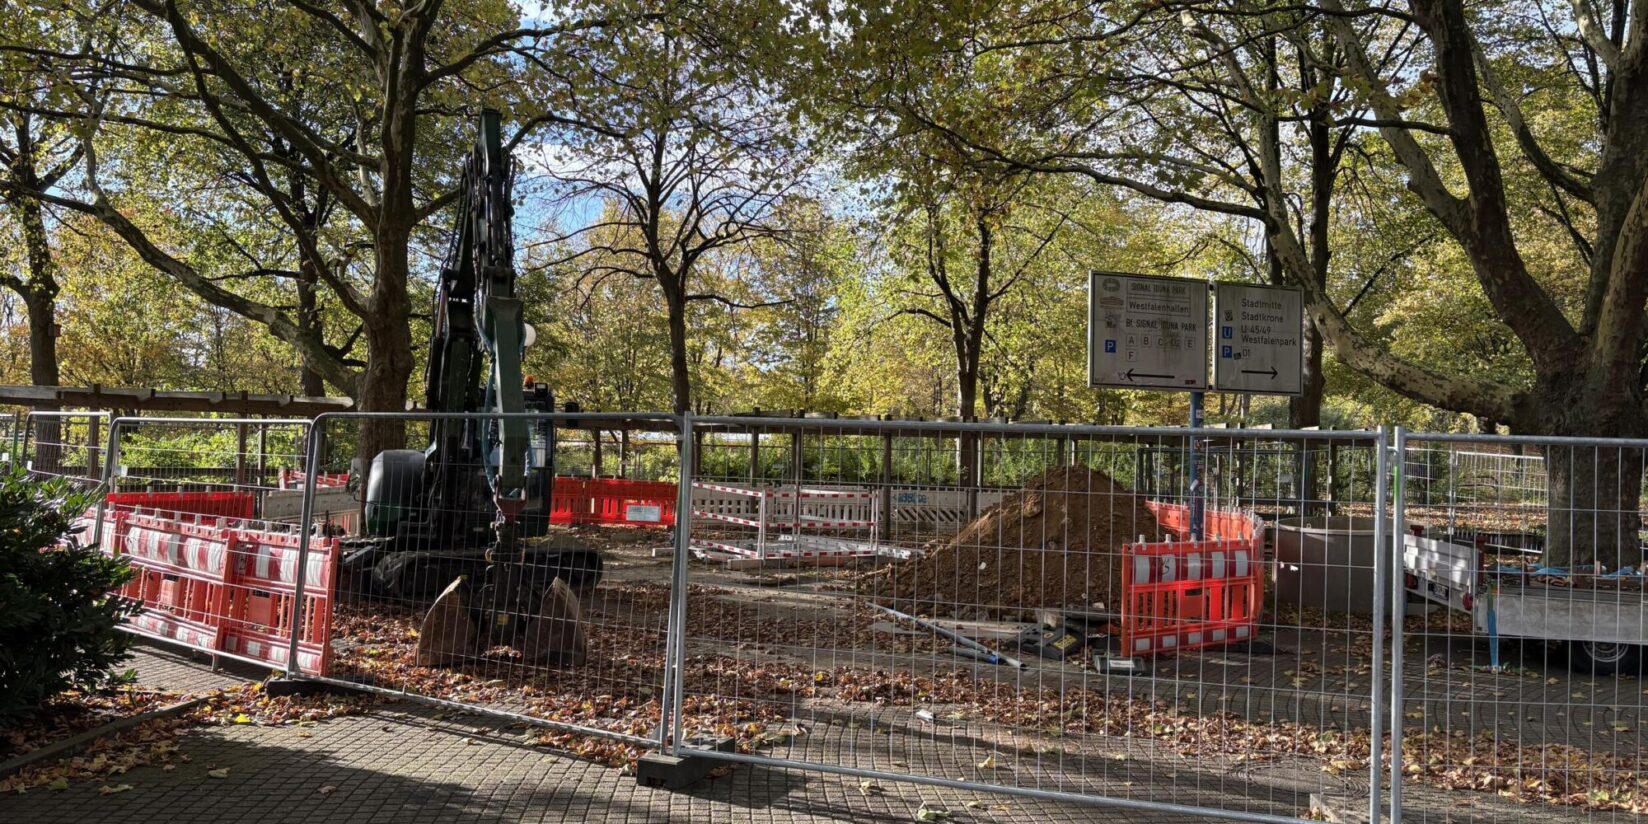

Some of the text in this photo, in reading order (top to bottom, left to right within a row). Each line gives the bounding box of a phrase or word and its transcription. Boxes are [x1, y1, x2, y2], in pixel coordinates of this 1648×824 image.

[1129, 301, 1189, 313] Westfalenhallen
[1241, 298, 1282, 310] Stadtmitte
[1241, 311, 1284, 323] Stadtkrone
[1136, 319, 1158, 329] SIGNAL
[1181, 322, 1197, 332] PARK
[1129, 336, 1135, 345] A
[1143, 336, 1149, 345] B
[1241, 335, 1297, 347] Westfalenpark
